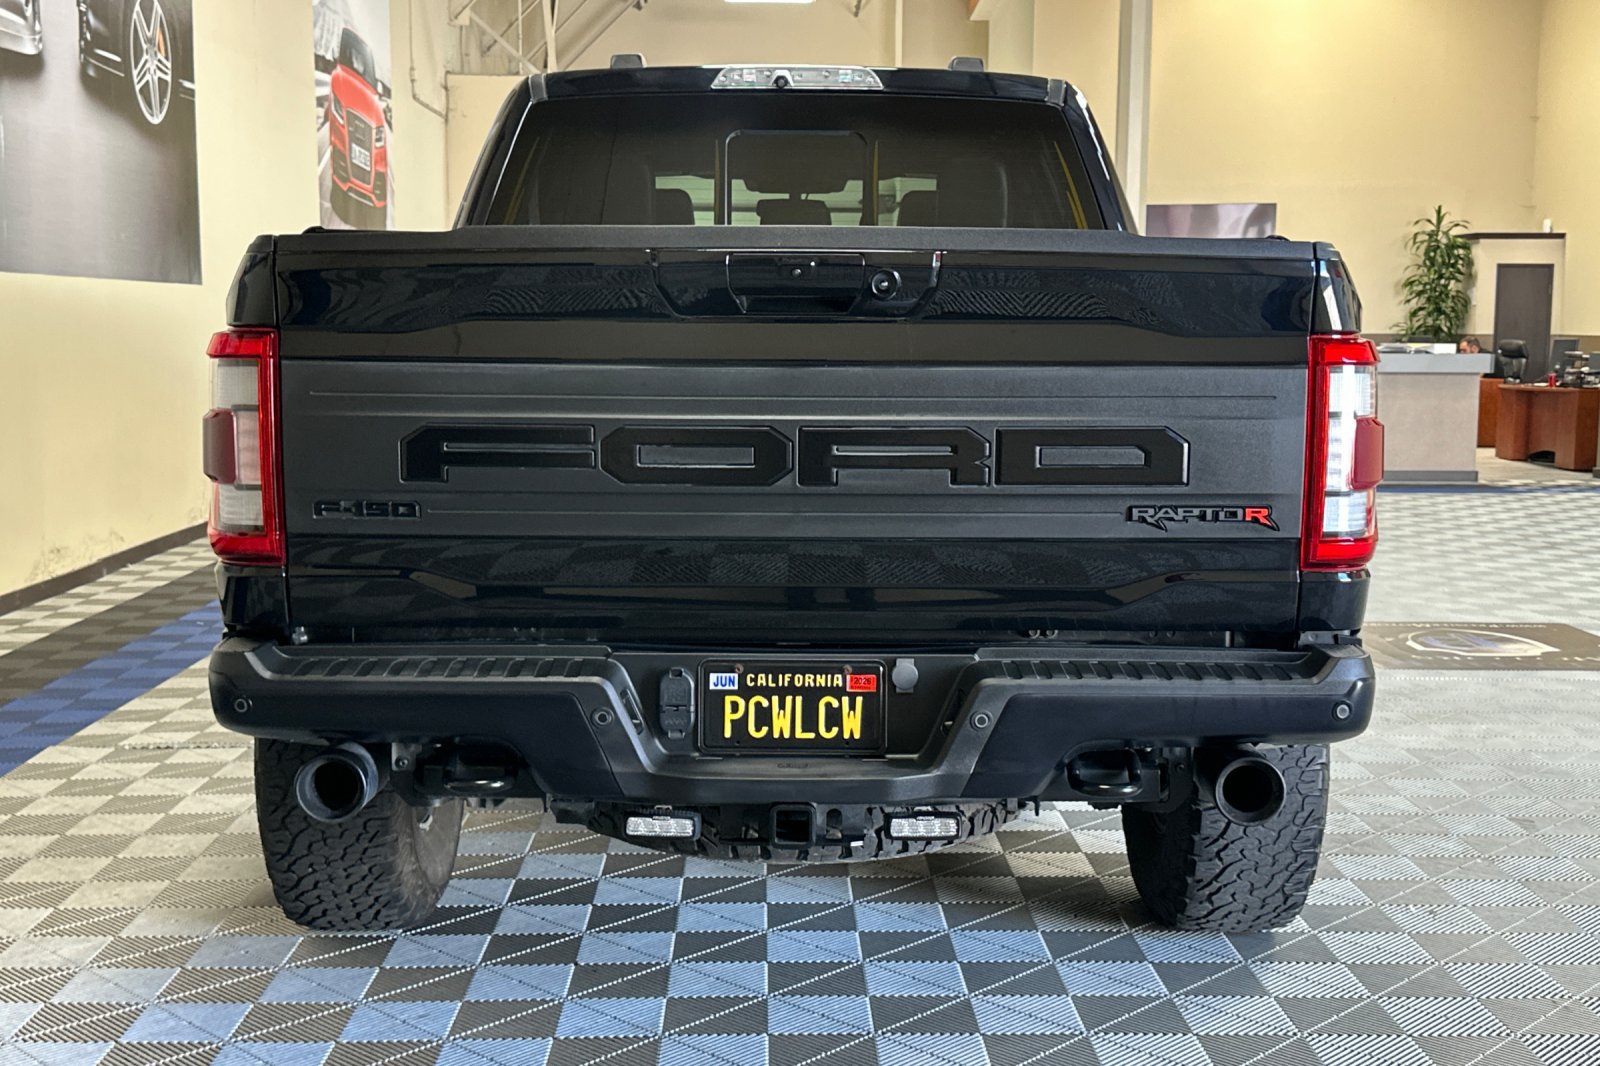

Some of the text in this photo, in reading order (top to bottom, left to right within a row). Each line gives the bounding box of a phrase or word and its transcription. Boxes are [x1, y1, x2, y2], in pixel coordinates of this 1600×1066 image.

[398, 425, 1190, 487] FORD
[1126, 504, 1280, 532] RAPTOR
[713, 675, 735, 688] JUN
[746, 673, 843, 687] CALIFORNIA
[723, 695, 863, 740] PCWLCW
